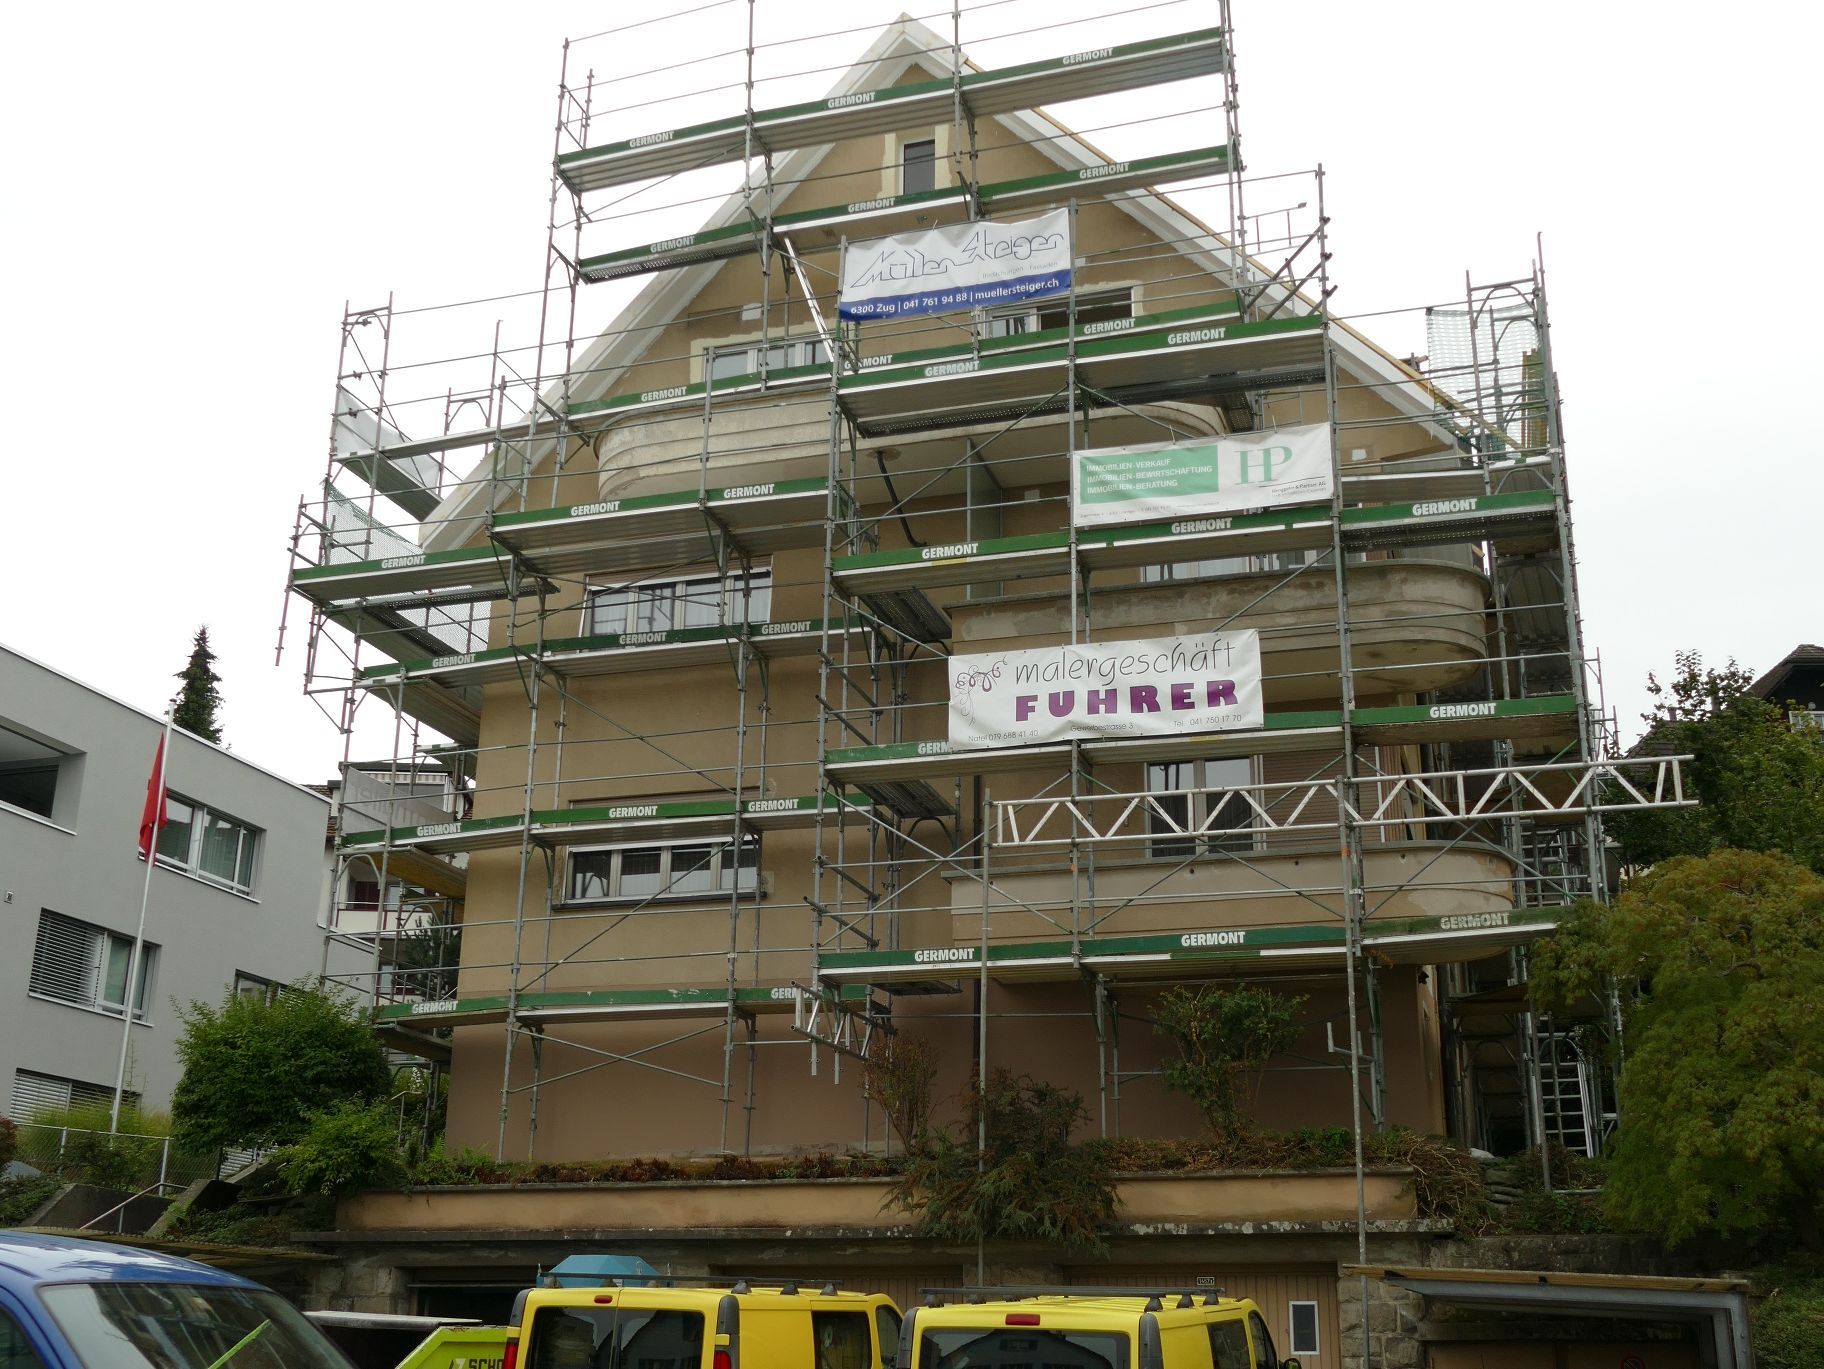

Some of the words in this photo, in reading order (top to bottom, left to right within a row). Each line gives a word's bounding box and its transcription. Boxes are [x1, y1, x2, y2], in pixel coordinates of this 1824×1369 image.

[1062, 48, 1114, 65] GERMONT
[828, 92, 876, 109] GERMONT
[629, 131, 675, 149] GERMONT
[1079, 162, 1130, 179] GERMONT
[848, 198, 896, 214] GERMONT
[650, 236, 695, 253] GERMONT
[850, 304, 875, 315] 6300
[876, 302, 896, 314] Zug
[903, 299, 919, 310] 041
[922, 297, 939, 307] 761
[941, 295, 954, 305] 94
[956, 291, 968, 302] 88
[975, 278, 1060, 300] muellersteiger.ch
[1084, 319, 1136, 335] GERMONT
[1168, 328, 1226, 345] GERMONT
[925, 360, 980, 377] GERMONT
[641, 386, 688, 402] GERMONT
[723, 484, 775, 498] GERMONT
[571, 501, 620, 516] GERMONT
[1412, 499, 1478, 516] GERMONT
[1171, 517, 1232, 534] GERMONT
[922, 543, 978, 559] GERMONT
[381, 555, 426, 569] GERMONT
[761, 621, 811, 634] GERMONT
[619, 632, 667, 645] GERMONT
[432, 653, 476, 667] GERMONT
[1015, 638, 1237, 687] malergeschäft
[1016, 679, 1239, 722] FUHRER
[1429, 702, 1496, 719] GERMONT
[1189, 717, 1203, 726] 041
[1206, 716, 1220, 725] 750
[1221, 715, 1230, 723] 17
[1231, 714, 1242, 722] 70
[968, 735, 988, 743] Natel
[988, 733, 1002, 742] 079
[1018, 730, 1026, 738] 41
[1028, 729, 1039, 738] 40
[917, 742, 951, 755] GERM
[609, 806, 658, 818] GERMONT
[748, 799, 799, 812] GERMONT
[417, 822, 462, 837] GERMONT
[1439, 912, 1510, 931] GERMONT
[1180, 931, 1246, 947] GERMONT
[913, 948, 975, 963] GERMONT
[411, 1000, 458, 1014] GERMONT
